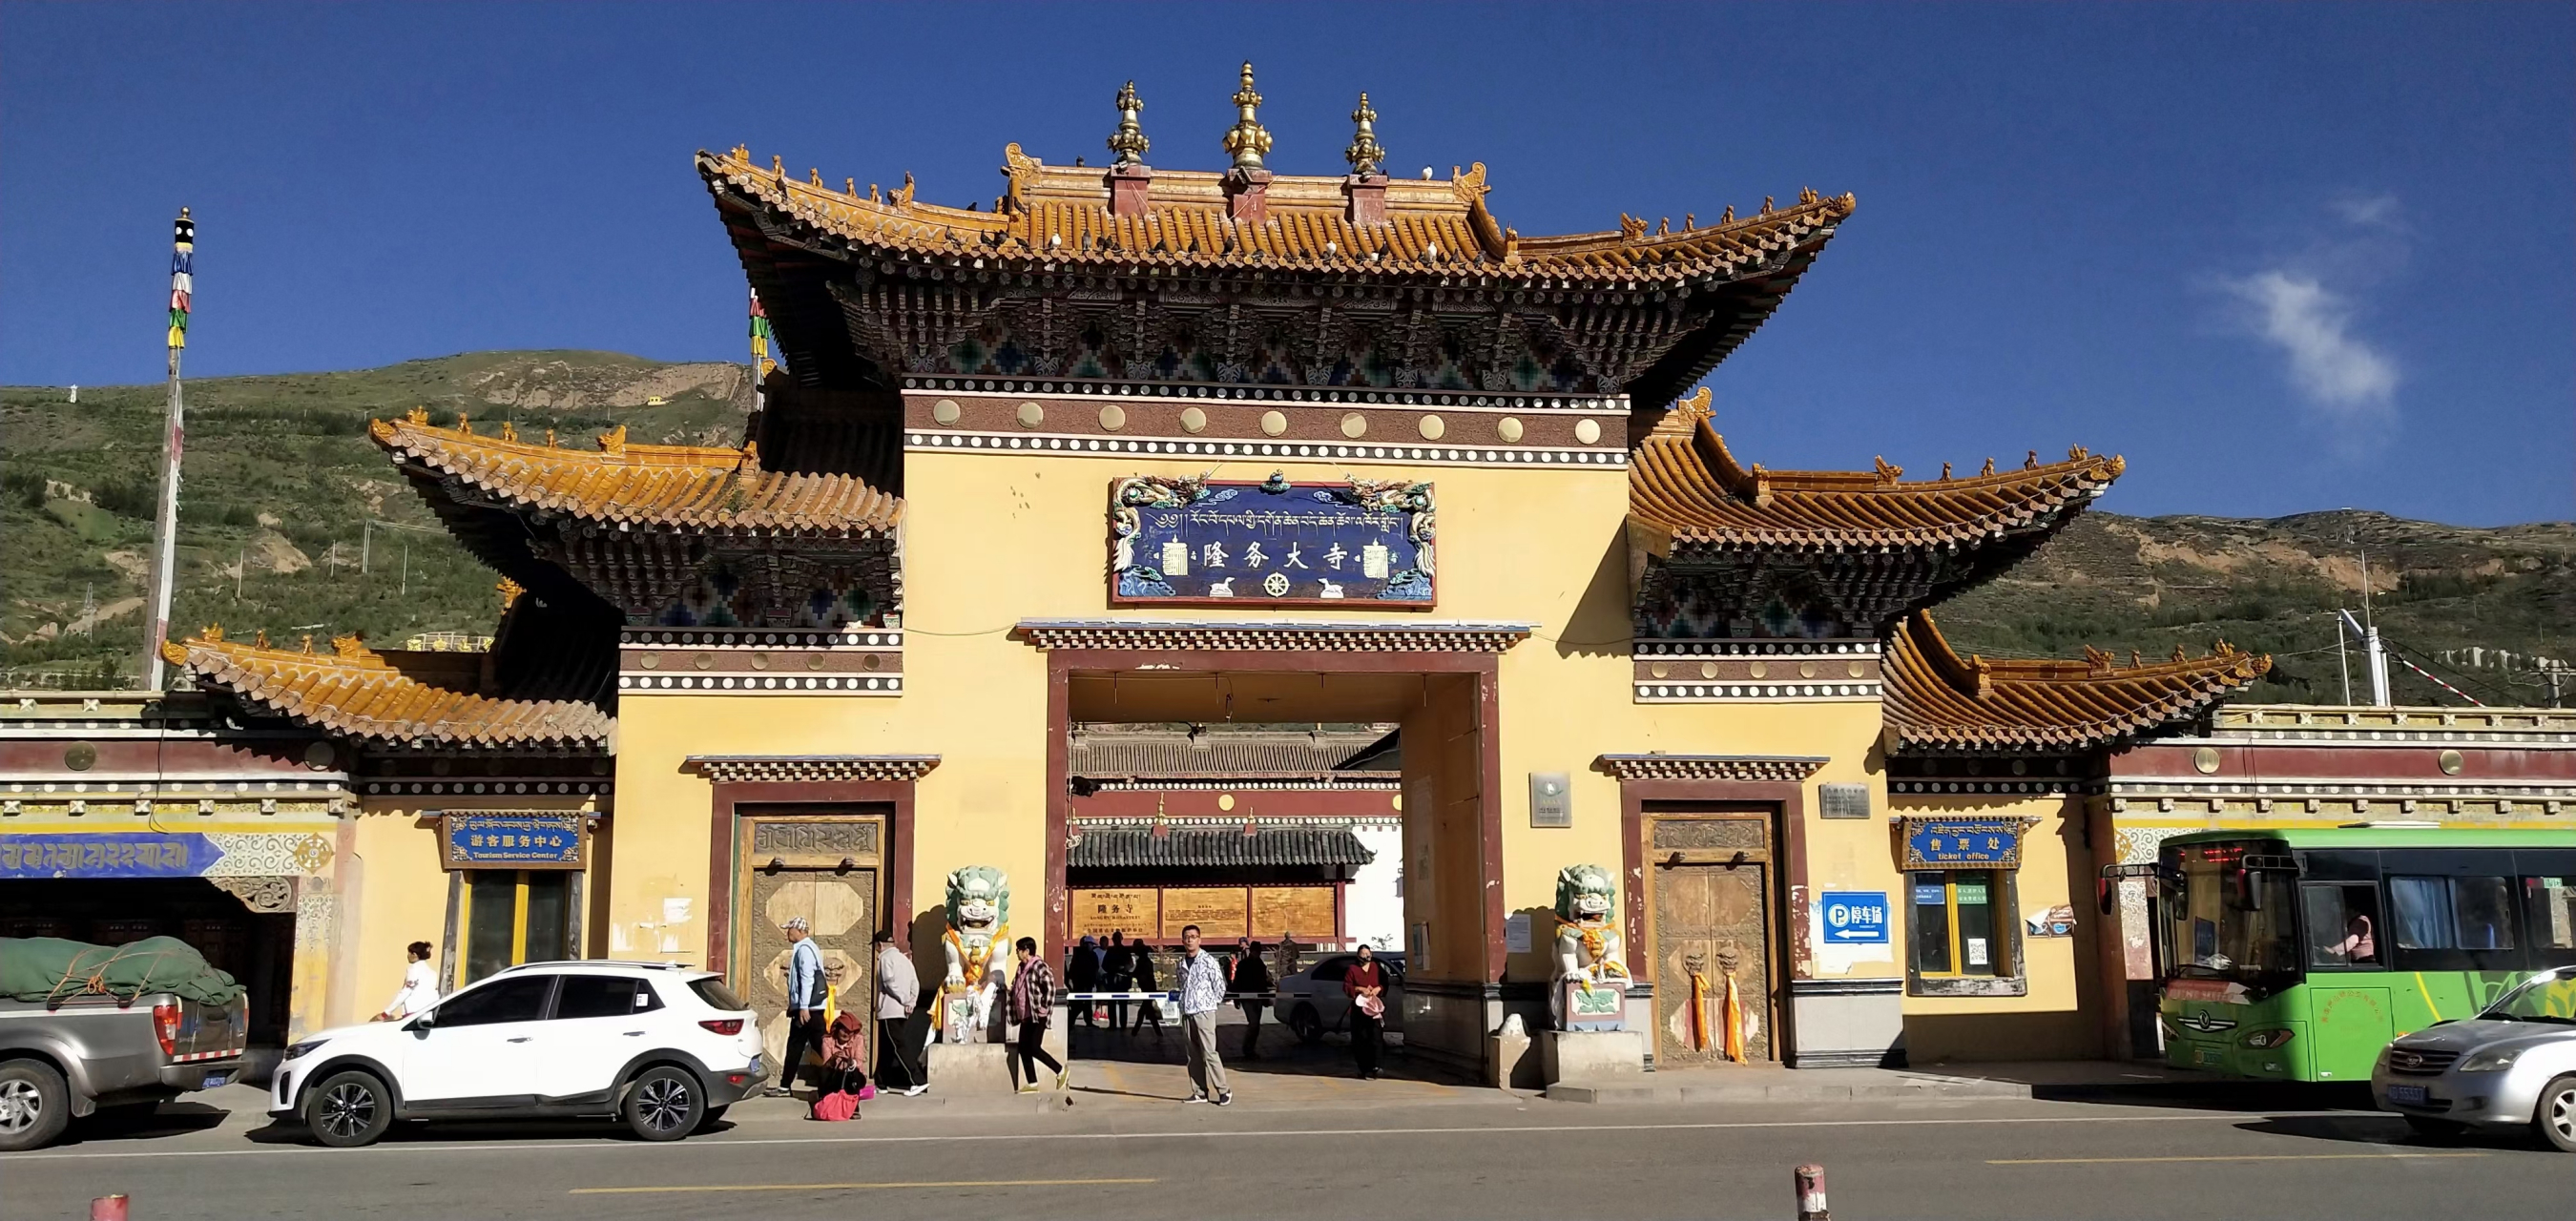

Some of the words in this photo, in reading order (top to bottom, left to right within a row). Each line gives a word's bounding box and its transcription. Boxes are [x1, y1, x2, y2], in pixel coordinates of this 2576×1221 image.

[1203, 541, 1348, 570] 隆务大寺
[470, 835, 562, 847] 游客服务中心
[1930, 838, 2000, 851] 售票处
[1938, 852, 1962, 860] ticket
[1966, 852, 1990, 860] office
[1851, 905, 1883, 924] 停车场
